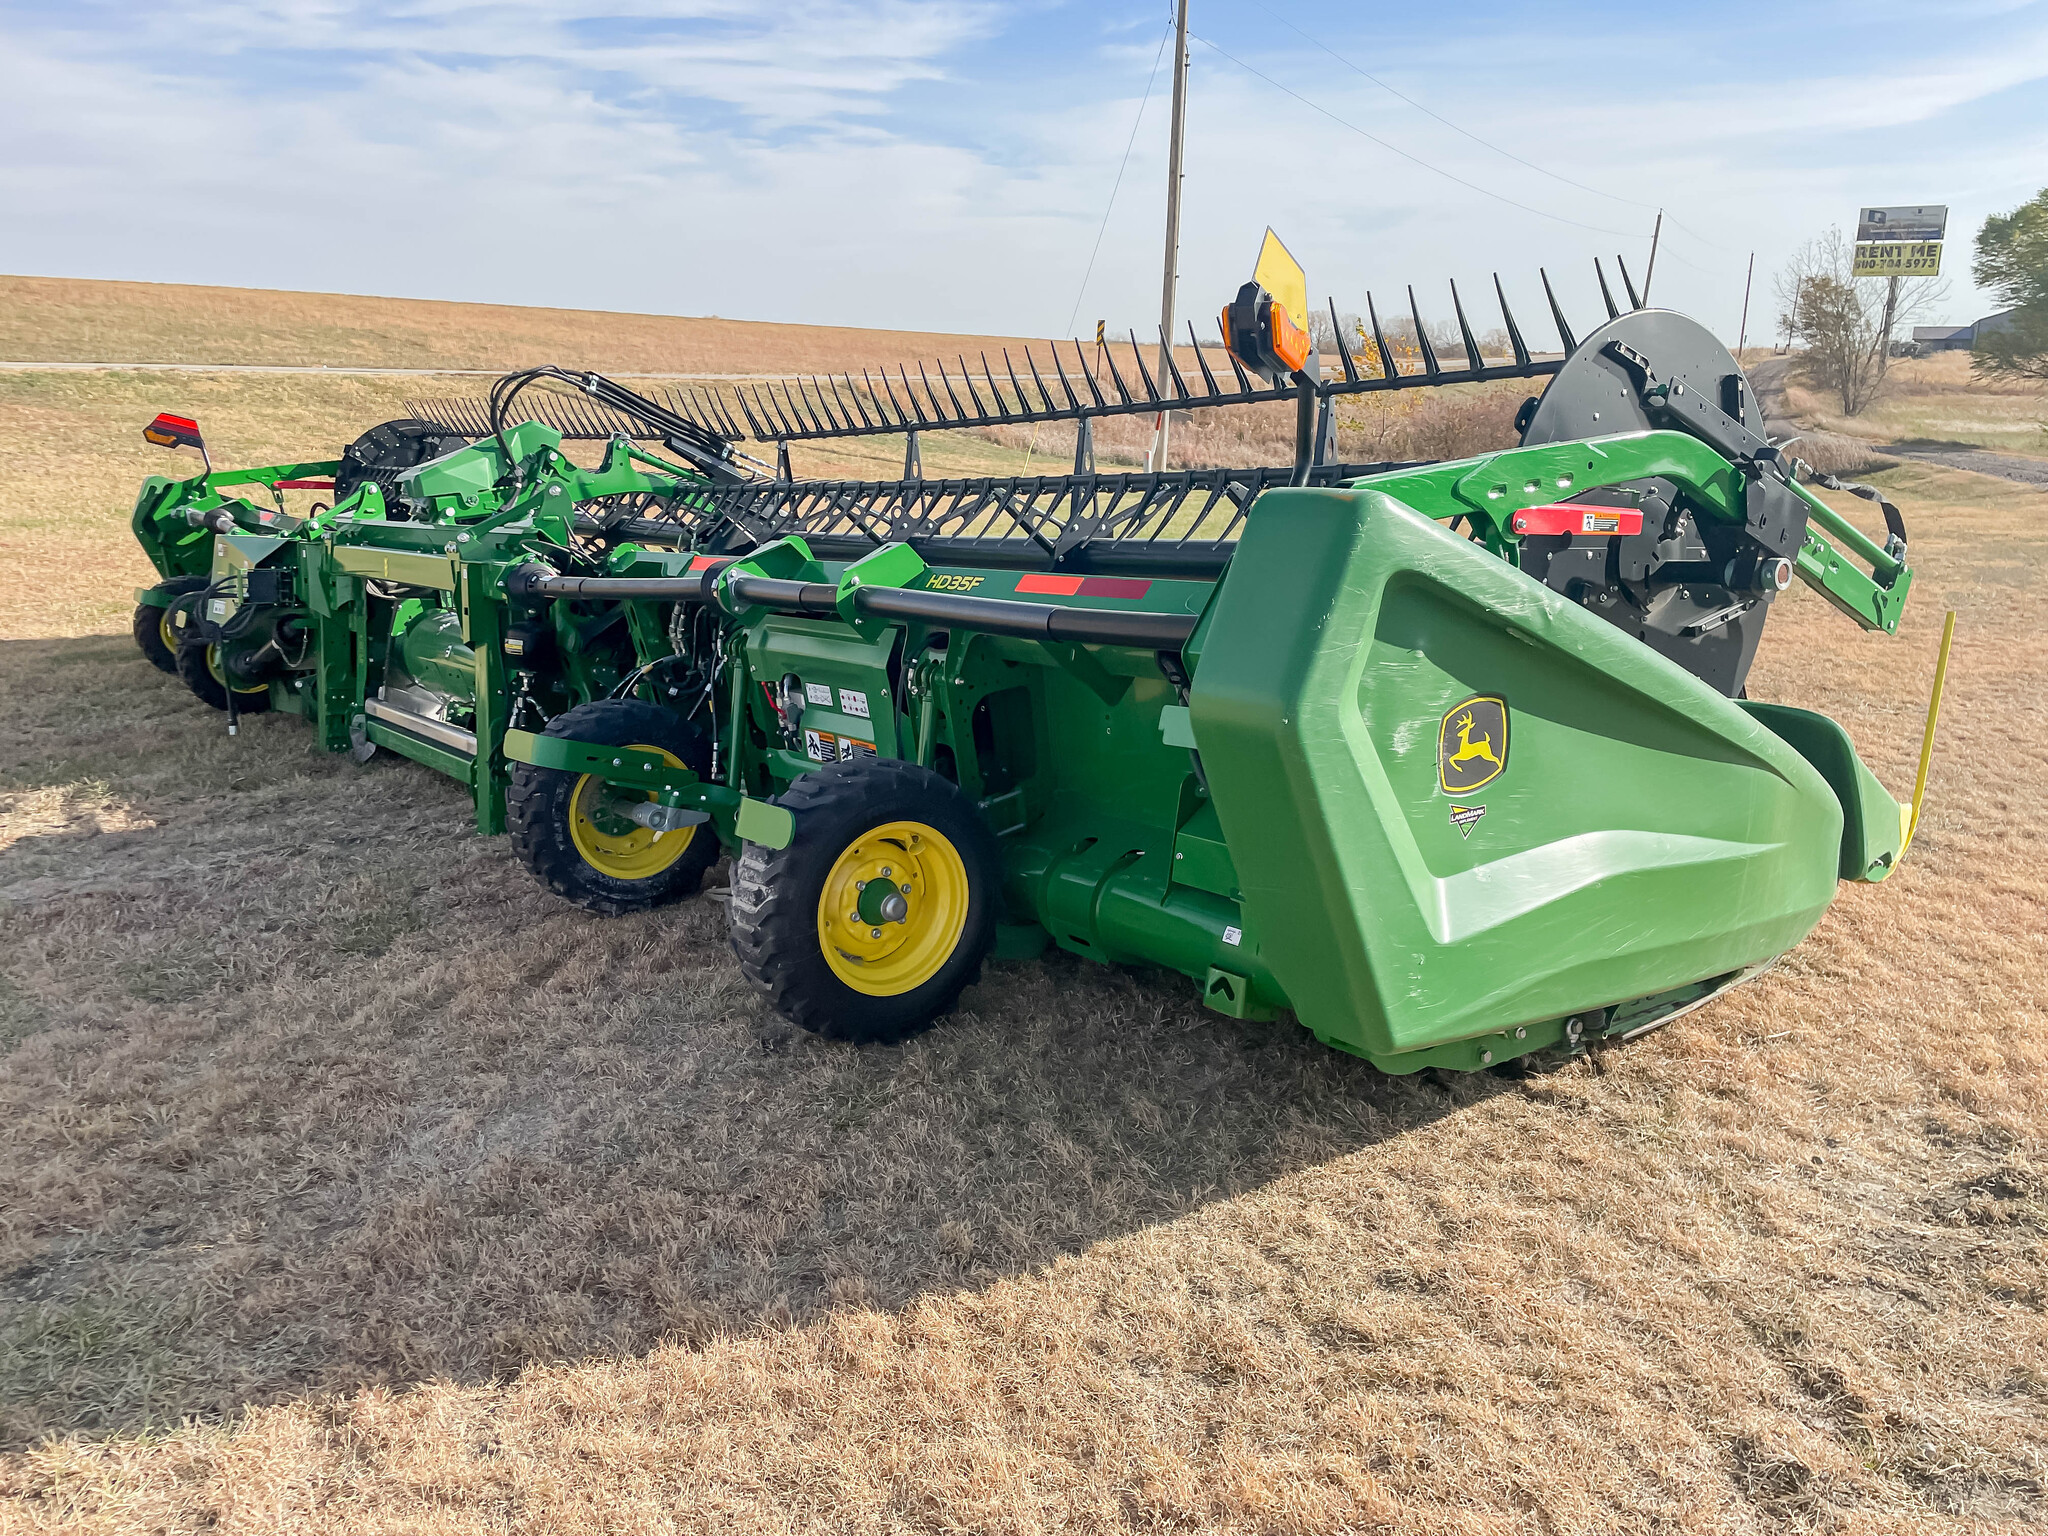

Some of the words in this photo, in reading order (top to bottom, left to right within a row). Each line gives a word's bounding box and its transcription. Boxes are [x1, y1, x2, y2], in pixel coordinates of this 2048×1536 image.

[1856, 245, 1902, 258] RENT
[1911, 245, 1938, 258] ME
[925, 574, 985, 591] HD35F
